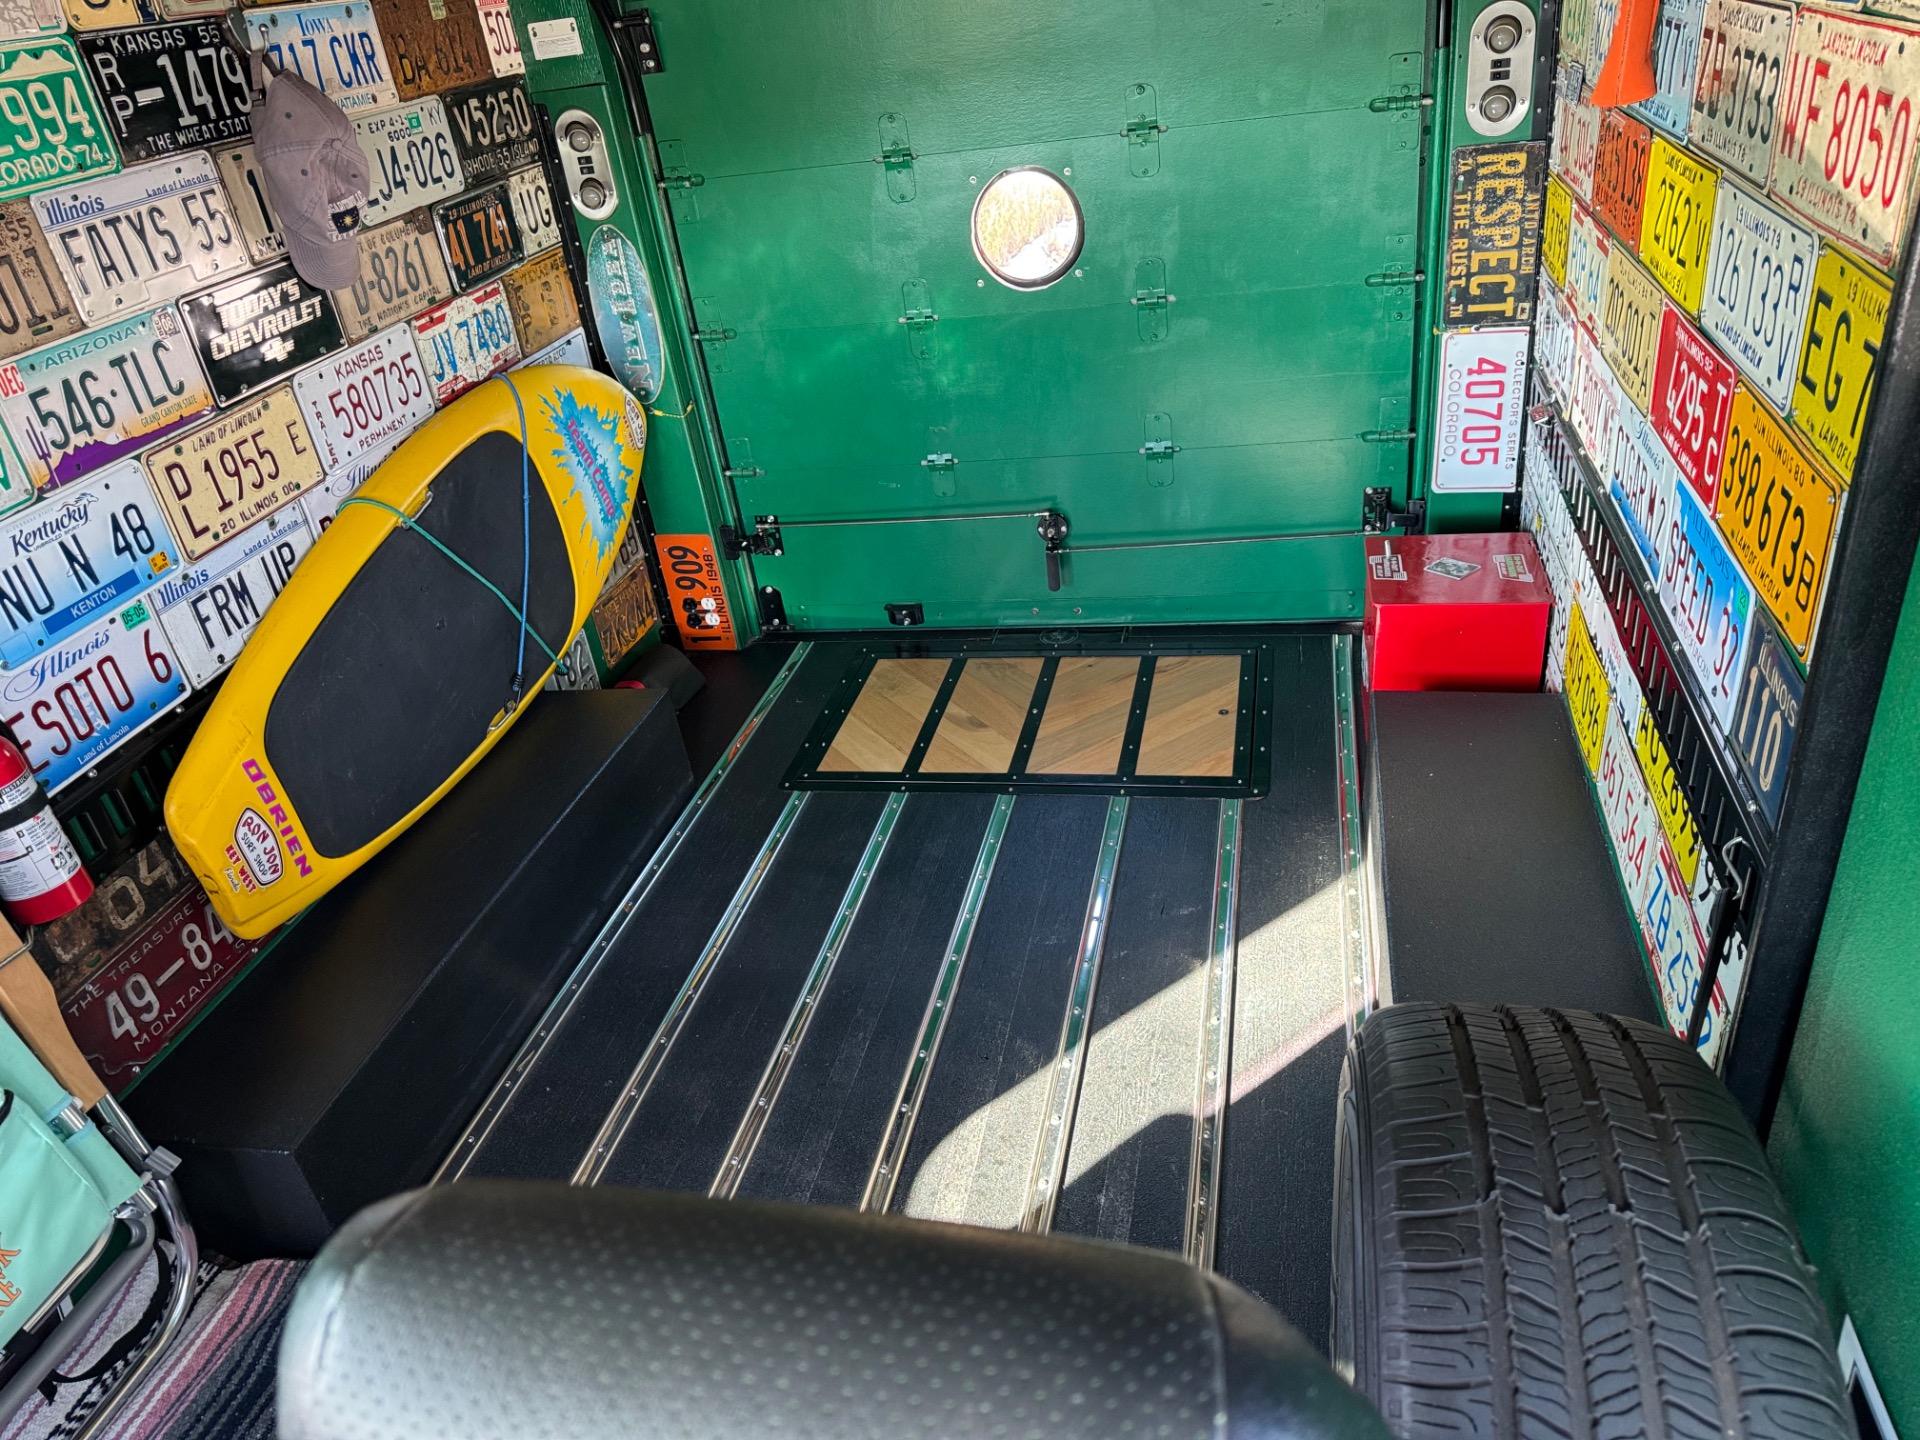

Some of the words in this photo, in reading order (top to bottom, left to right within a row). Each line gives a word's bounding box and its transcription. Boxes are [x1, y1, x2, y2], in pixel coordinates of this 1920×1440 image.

[110, 28, 187, 54] KANSAS
[197, 25, 220, 44] 55
[329, 31, 385, 89] CKR
[484, 10, 521, 56] 501
[1820, 31, 1841, 54] LAND
[1849, 38, 1888, 66] LINCOLN
[1694, 28, 1726, 118] ZB
[1725, 46, 1779, 142] 3733
[146, 134, 175, 152] THE
[177, 127, 216, 146] WHEAT
[368, 119, 386, 134] EXP
[388, 127, 412, 143] 6000
[427, 105, 442, 126] KY
[453, 87, 532, 148] V5250
[1713, 131, 1736, 157] ILLINOIS
[1780, 54, 1829, 163] WF
[1824, 80, 1909, 206] 8050
[0, 145, 74, 186] ORADO
[465, 158, 495, 176] RHODE
[495, 148, 513, 167] 55
[512, 139, 540, 162] ISLAND
[46, 195, 105, 225] Illinois
[146, 181, 167, 197] Land
[168, 182, 178, 192] of
[179, 173, 210, 189] Lincoln
[1453, 191, 1471, 230] THE
[1653, 177, 1691, 268] 2762
[1735, 204, 1743, 223] 19
[1743, 211, 1770, 242] ILLINOIS
[1770, 228, 1780, 250] 79
[1806, 181, 1843, 218] ILLINOIS
[58, 205, 183, 297] FATYS
[180, 188, 233, 252] 55
[367, 236, 378, 250] OF
[447, 218, 475, 271] 41
[473, 203, 513, 259] 741
[1450, 238, 1470, 288] RUST
[1467, 152, 1528, 318] RESPECT
[468, 266, 483, 279] LAND
[1587, 254, 1600, 311] 64
[1712, 221, 1742, 311] 126
[1744, 247, 1783, 346] 133
[163, 316, 174, 332] 08
[211, 295, 322, 361] CHEVROLET
[216, 278, 300, 329] TODAY'S
[357, 317, 374, 331] THE
[413, 286, 441, 305] CAPITAL
[1605, 276, 1624, 346] 202
[1621, 300, 1645, 376] 001
[44, 327, 137, 370] ARIZONA
[333, 345, 384, 382] KANSAS
[432, 330, 458, 382] JV
[457, 303, 511, 364] 7480
[1703, 353, 1713, 378] 92
[1719, 317, 1733, 340] LAND
[1738, 337, 1762, 368] LINCOLN
[0, 365, 26, 398] DEC
[328, 352, 422, 439] 580735
[1509, 350, 1526, 427] COLLECTOR'S
[1666, 352, 1707, 450] 4295
[140, 414, 161, 429] GRAND
[161, 404, 182, 423] CANYON
[181, 394, 198, 409] STATE
[190, 434, 216, 453] LAND
[217, 423, 229, 440] OF
[230, 407, 263, 434] LINCOLN
[311, 400, 339, 466] TRAILER
[358, 414, 408, 451] PERMANENT
[1443, 368, 1462, 458] COLORADO
[1460, 356, 1507, 466] 40705
[204, 430, 283, 513] 1955
[285, 420, 307, 456] E
[567, 417, 594, 468] Team
[591, 467, 615, 518] Comp
[1504, 432, 1518, 470] SERIES
[1631, 411, 1662, 471] Illinois
[1663, 421, 1674, 450] LAND
[1679, 445, 1697, 483] LINCOLN
[1753, 416, 1766, 438] JUN
[1765, 429, 1793, 473] ILLINOIS
[1793, 463, 1804, 487] 80
[1818, 421, 1838, 452] LAND
[1836, 441, 1848, 461] OF
[1613, 425, 1647, 525] CIGAR
[1653, 497, 1665, 561] 2
[1724, 426, 1760, 527] 398
[9, 503, 89, 558] Kentucky
[33, 533, 63, 552] UNBRIDLED
[63, 524, 81, 536] SPIRIT
[220, 517, 236, 534] 20
[238, 492, 279, 524] ILLINOIS
[0, 557, 55, 631] NU
[58, 533, 101, 593] N
[110, 503, 156, 564] 48
[158, 568, 210, 607] Illinois
[243, 540, 262, 556] Land
[272, 519, 300, 539] Lincoln
[159, 550, 167, 562] 3
[668, 545, 707, 591] 909
[707, 553, 720, 581] 1948
[1692, 508, 1729, 579] ILLINOIS
[1735, 529, 1749, 558] LAND
[1754, 561, 1781, 602] LINCOLN
[70, 584, 117, 618] KENTON
[121, 604, 146, 626] 05-05
[190, 570, 260, 649] FRM
[260, 541, 296, 599] UP
[1665, 521, 1713, 643] SPEED
[1713, 606, 1738, 697] 32
[4, 630, 110, 701] Illinois
[143, 628, 172, 684] 6
[1677, 612, 1688, 638] LAND
[1691, 641, 1710, 681] LINCOLN
[1568, 632, 1583, 696] 409
[1581, 673, 1600, 747] 096
[1757, 642, 1798, 728] ILLINOIS
[77, 748, 97, 766] Land
[96, 740, 105, 753] of
[104, 723, 130, 748] Lincoln
[1739, 666, 1782, 792] 110
[1602, 736, 1624, 814] 667
[1621, 789, 1646, 883] 564
[1648, 767, 1658, 793] LAND
[1660, 800, 1676, 841] LINCOLN
[225, 844, 241, 866] KEY
[238, 865, 257, 894] WEST
[241, 832, 257, 853] SURF
[254, 854, 268, 876] SHOP
[242, 816, 270, 844] RON
[263, 845, 280, 875] JON
[1646, 865, 1671, 952] ZB
[68, 982, 105, 1018] THE
[107, 903, 194, 982] TREASURE
[133, 962, 224, 1052] MONTANA
